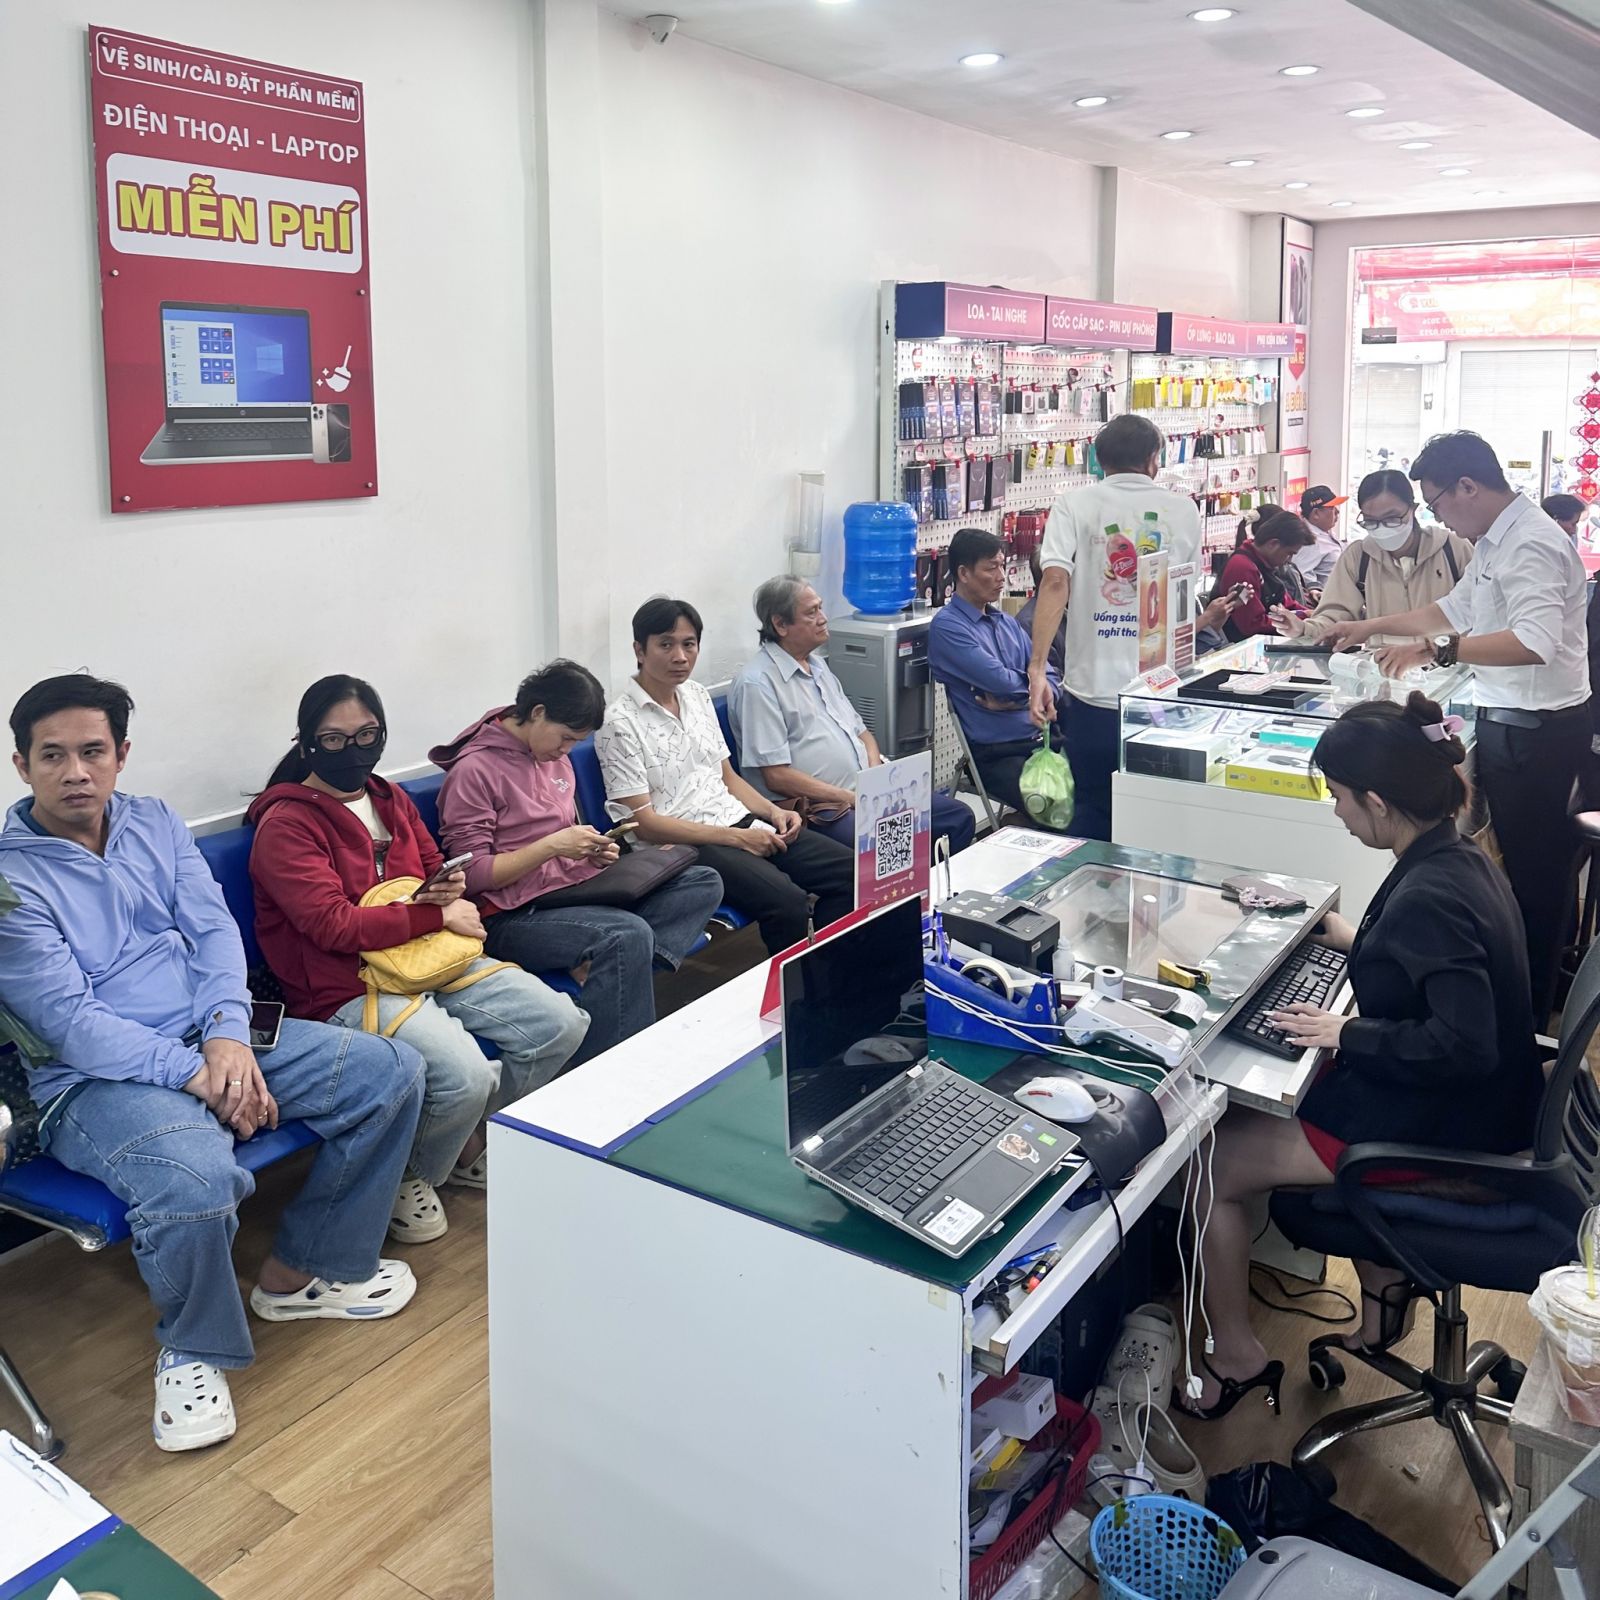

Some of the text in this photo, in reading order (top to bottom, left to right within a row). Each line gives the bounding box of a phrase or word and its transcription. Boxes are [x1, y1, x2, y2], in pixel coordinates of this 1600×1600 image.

[102, 46, 356, 111] VỆ SINH/CÀI ĐẶT PHẦN MỀM
[103, 103, 168, 136] ĐIỆN
[174, 115, 249, 152] THOẠI
[271, 132, 359, 164] LAPTOP
[116, 173, 359, 254] MIỄN PHÍ
[967, 304, 985, 320] LOA
[991, 306, 1004, 321] TAI
[1004, 308, 1027, 324] NGHE
[1052, 309, 1070, 328] CỐC
[1072, 313, 1089, 330] CÁP
[1089, 318, 1104, 335] SẠC
[1109, 319, 1121, 333] PIN
[1121, 320, 1132, 338] DỰ
[1227, 333, 1235, 345] DA
[1093, 611, 1118, 624] Uống
[1097, 627, 1121, 639] nghĩ
